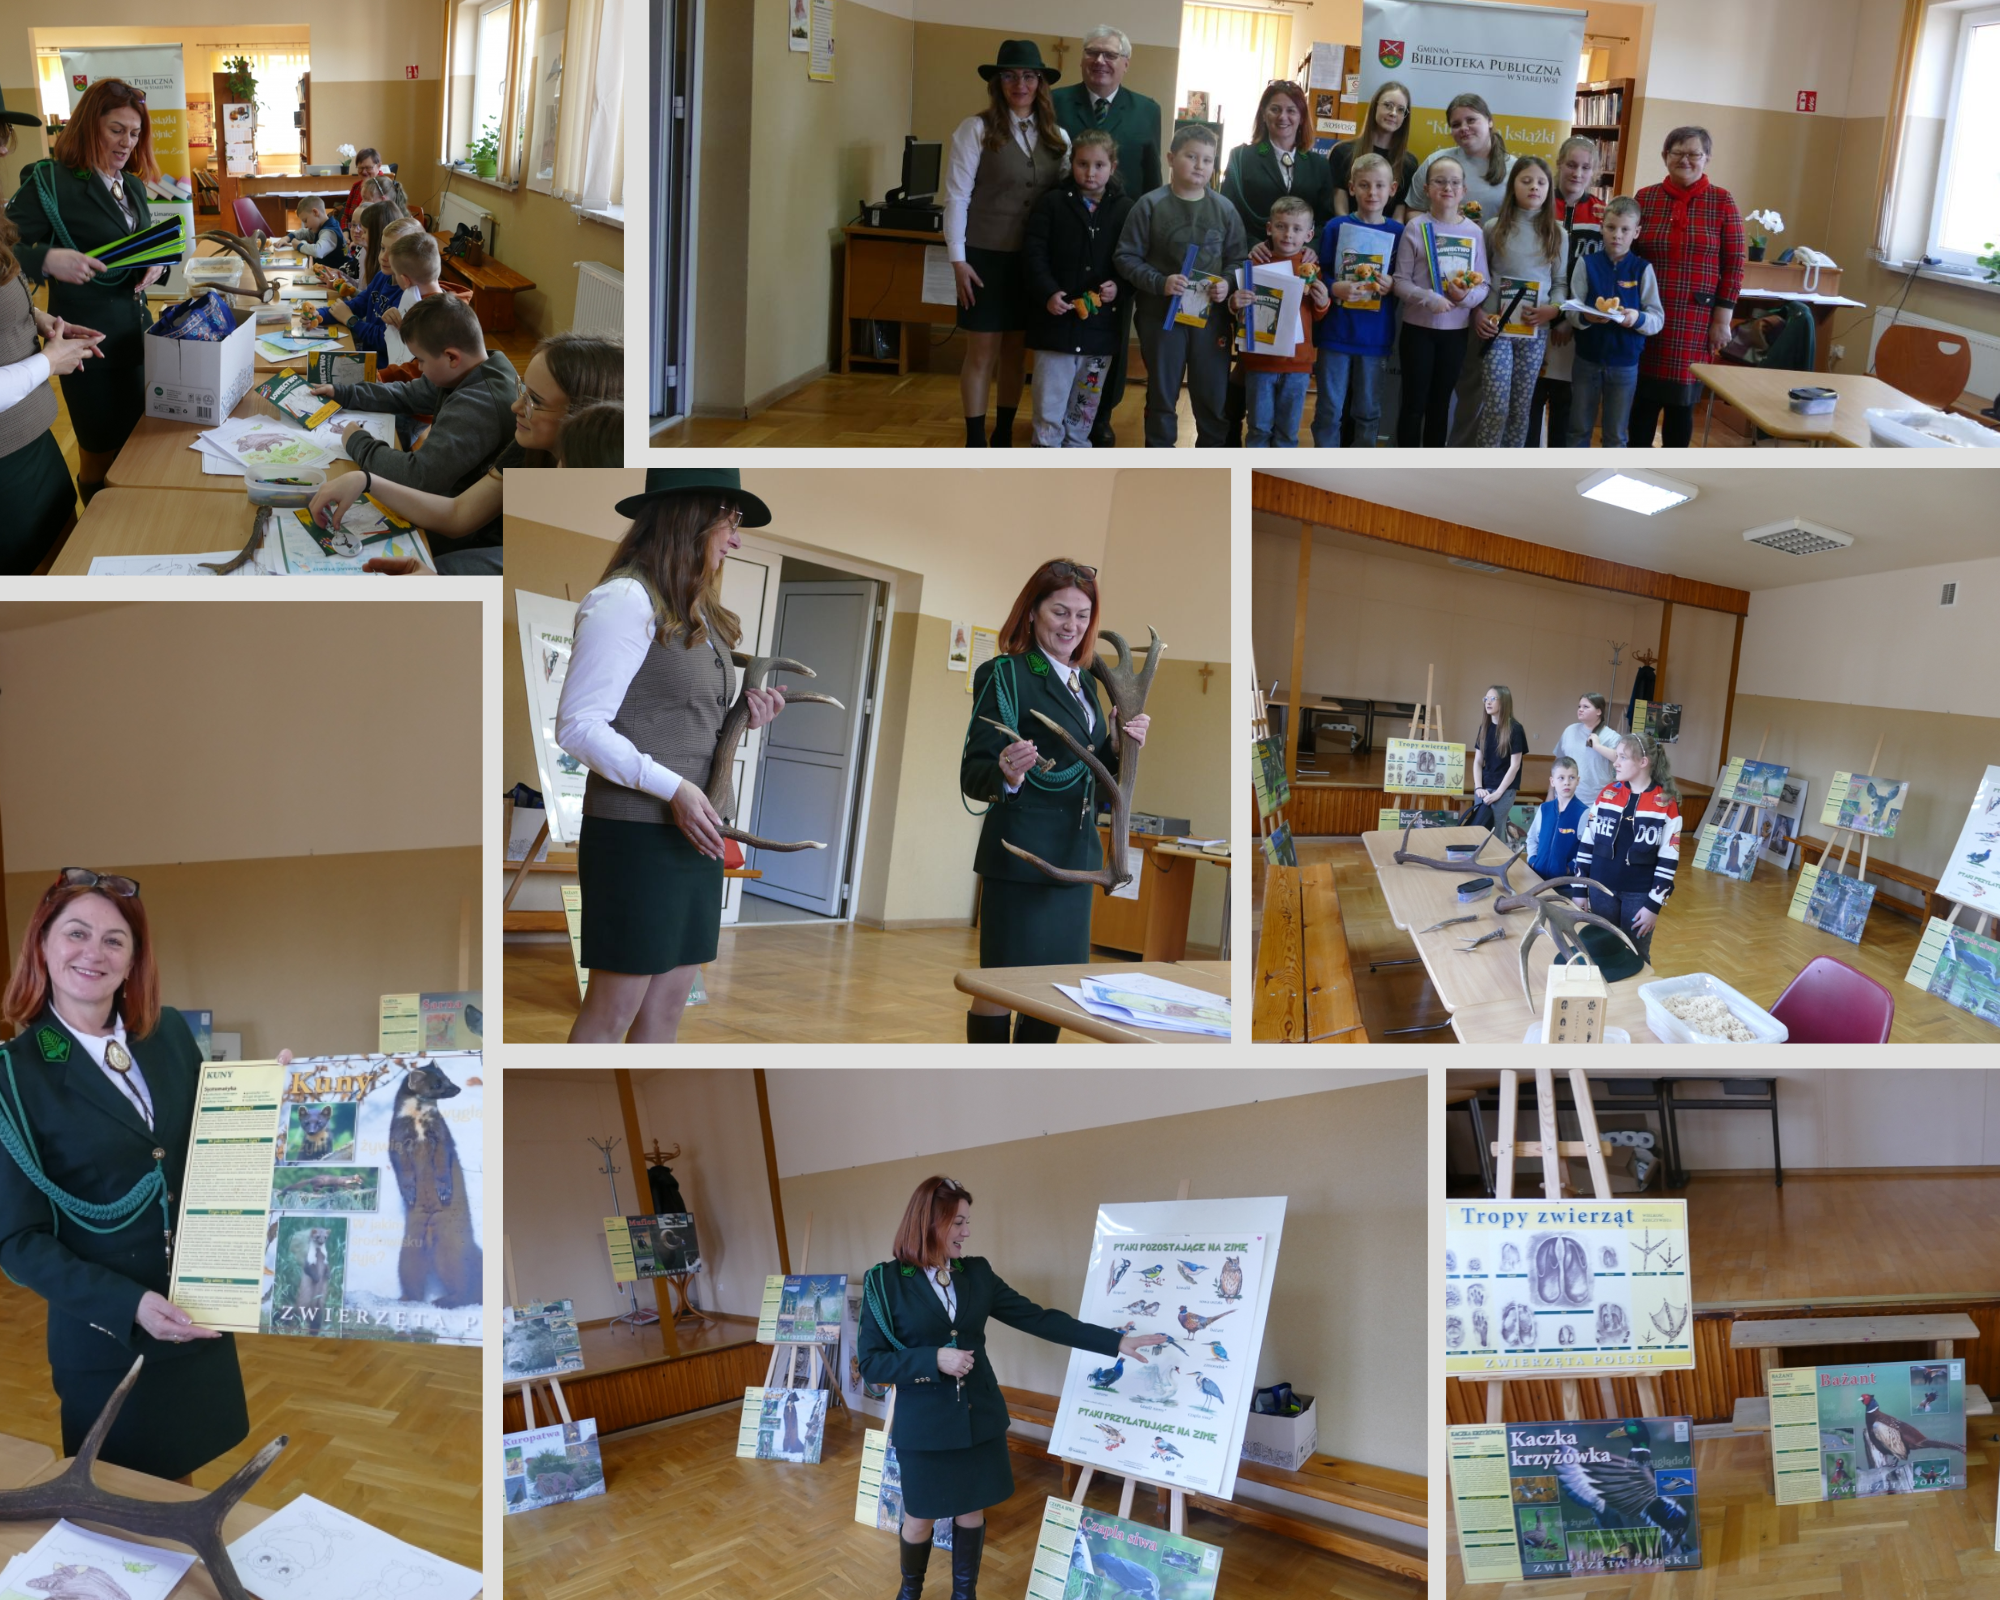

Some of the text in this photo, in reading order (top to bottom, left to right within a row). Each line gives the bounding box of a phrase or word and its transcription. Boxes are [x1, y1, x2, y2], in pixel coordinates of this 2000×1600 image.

[1411, 52, 1562, 77] BIBLIOTEKA PUBLICZNA
[134, 78, 174, 86] PUBLICZNA
[1505, 125, 1555, 145] książki
[541, 632, 563, 644] PTAKI
[1398, 740, 1420, 749] Tropy
[423, 998, 463, 1011] Sarna
[206, 1071, 234, 1079] KUNY
[290, 1070, 374, 1097] Kuny
[628, 1218, 657, 1227] Muflon
[1461, 1207, 1634, 1229] Tropy zwierząt
[1114, 1243, 1249, 1253] PTAKI POZOSTAJĄCE NA ZIMĘ
[280, 1304, 447, 1331] ZWIERZĘTA
[1485, 1354, 1654, 1368] ZWIERZĘTA POLSKI
[1820, 1372, 1876, 1388] Bażant
[1078, 1407, 1218, 1444] PTAKI PRZYLATUJĄCE NA ZIMĘ
[503, 1431, 560, 1447] Kuropatwa
[1509, 1429, 1578, 1448] Kaczka
[1510, 1447, 1611, 1470] krzyżówka
[1831, 1476, 1957, 1495] ZWIERZĘTA POLSKI
[1082, 1516, 1158, 1552] Czapla siwa
[1533, 1556, 1690, 1573] ZWIERZĘTA POLSKI
